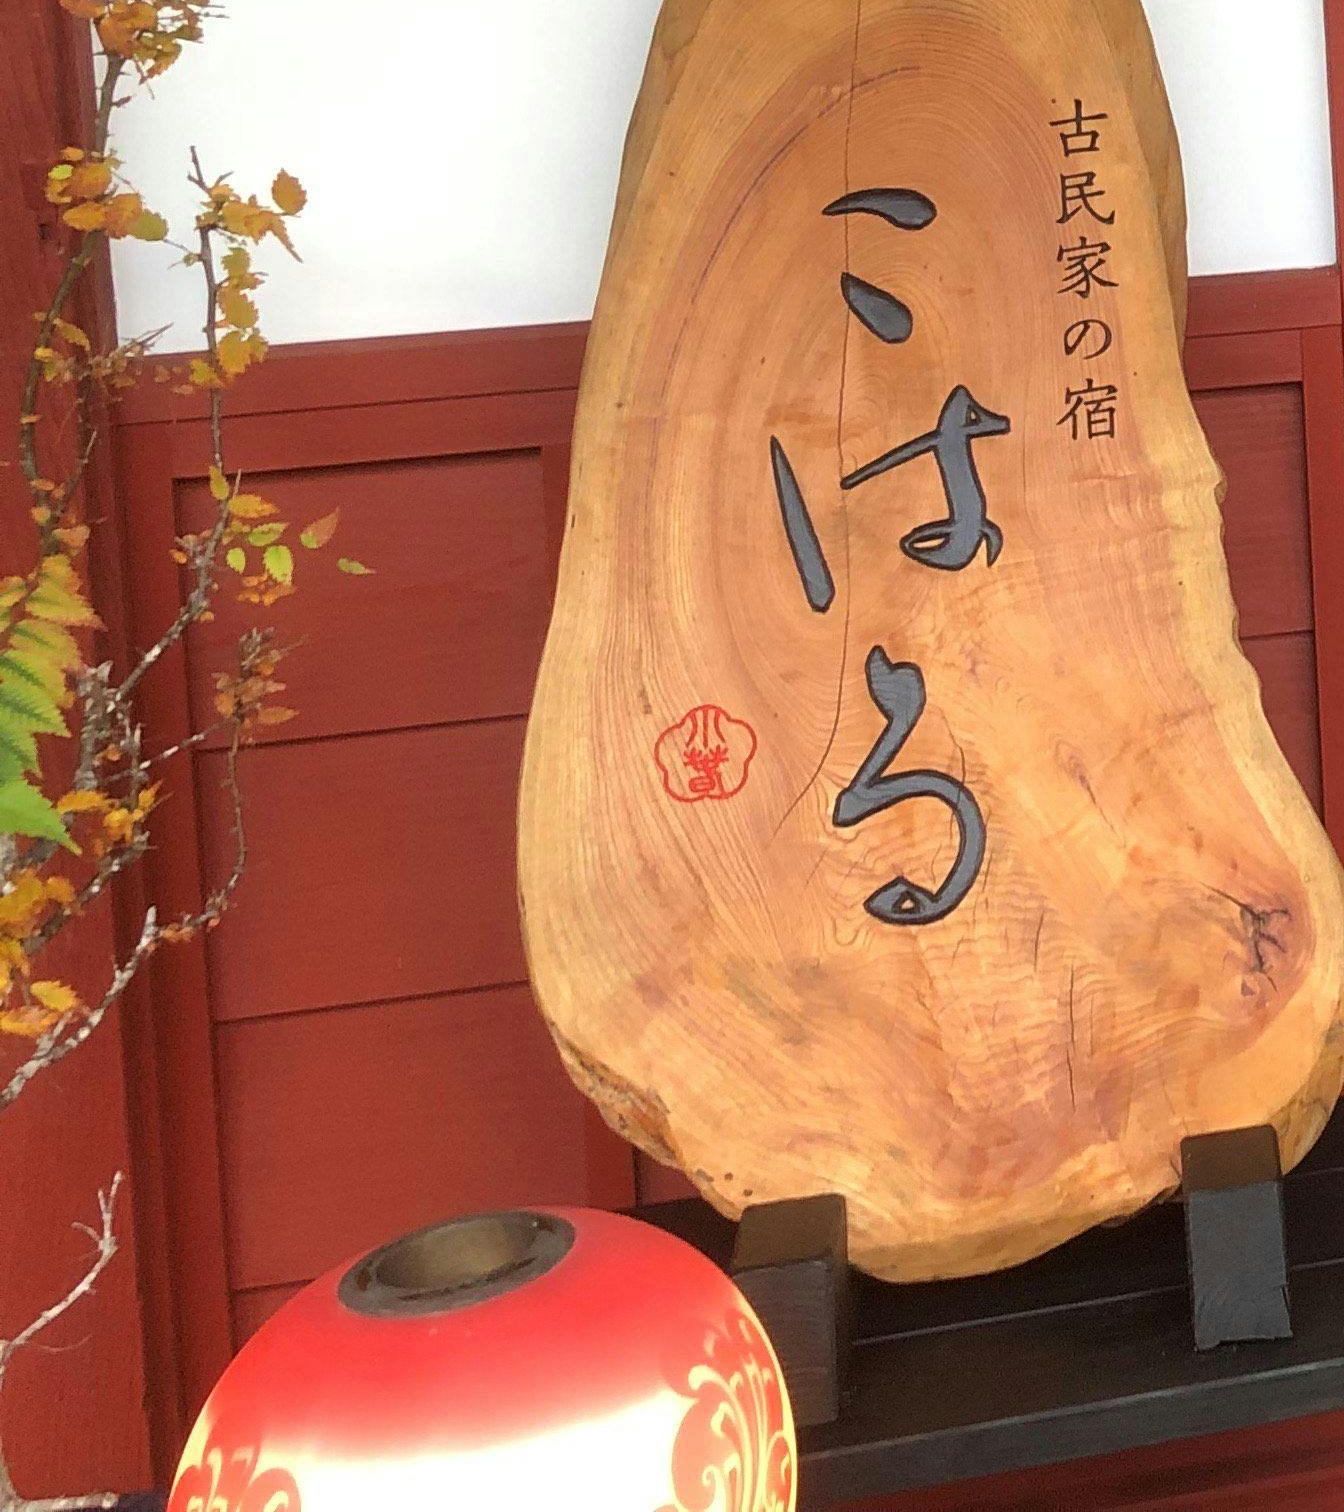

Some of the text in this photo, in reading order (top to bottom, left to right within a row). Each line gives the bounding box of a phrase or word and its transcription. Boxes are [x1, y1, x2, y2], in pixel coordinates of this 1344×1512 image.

[1049, 98, 1120, 441] 古民家の宿
[770, 187, 1011, 926] こはる
